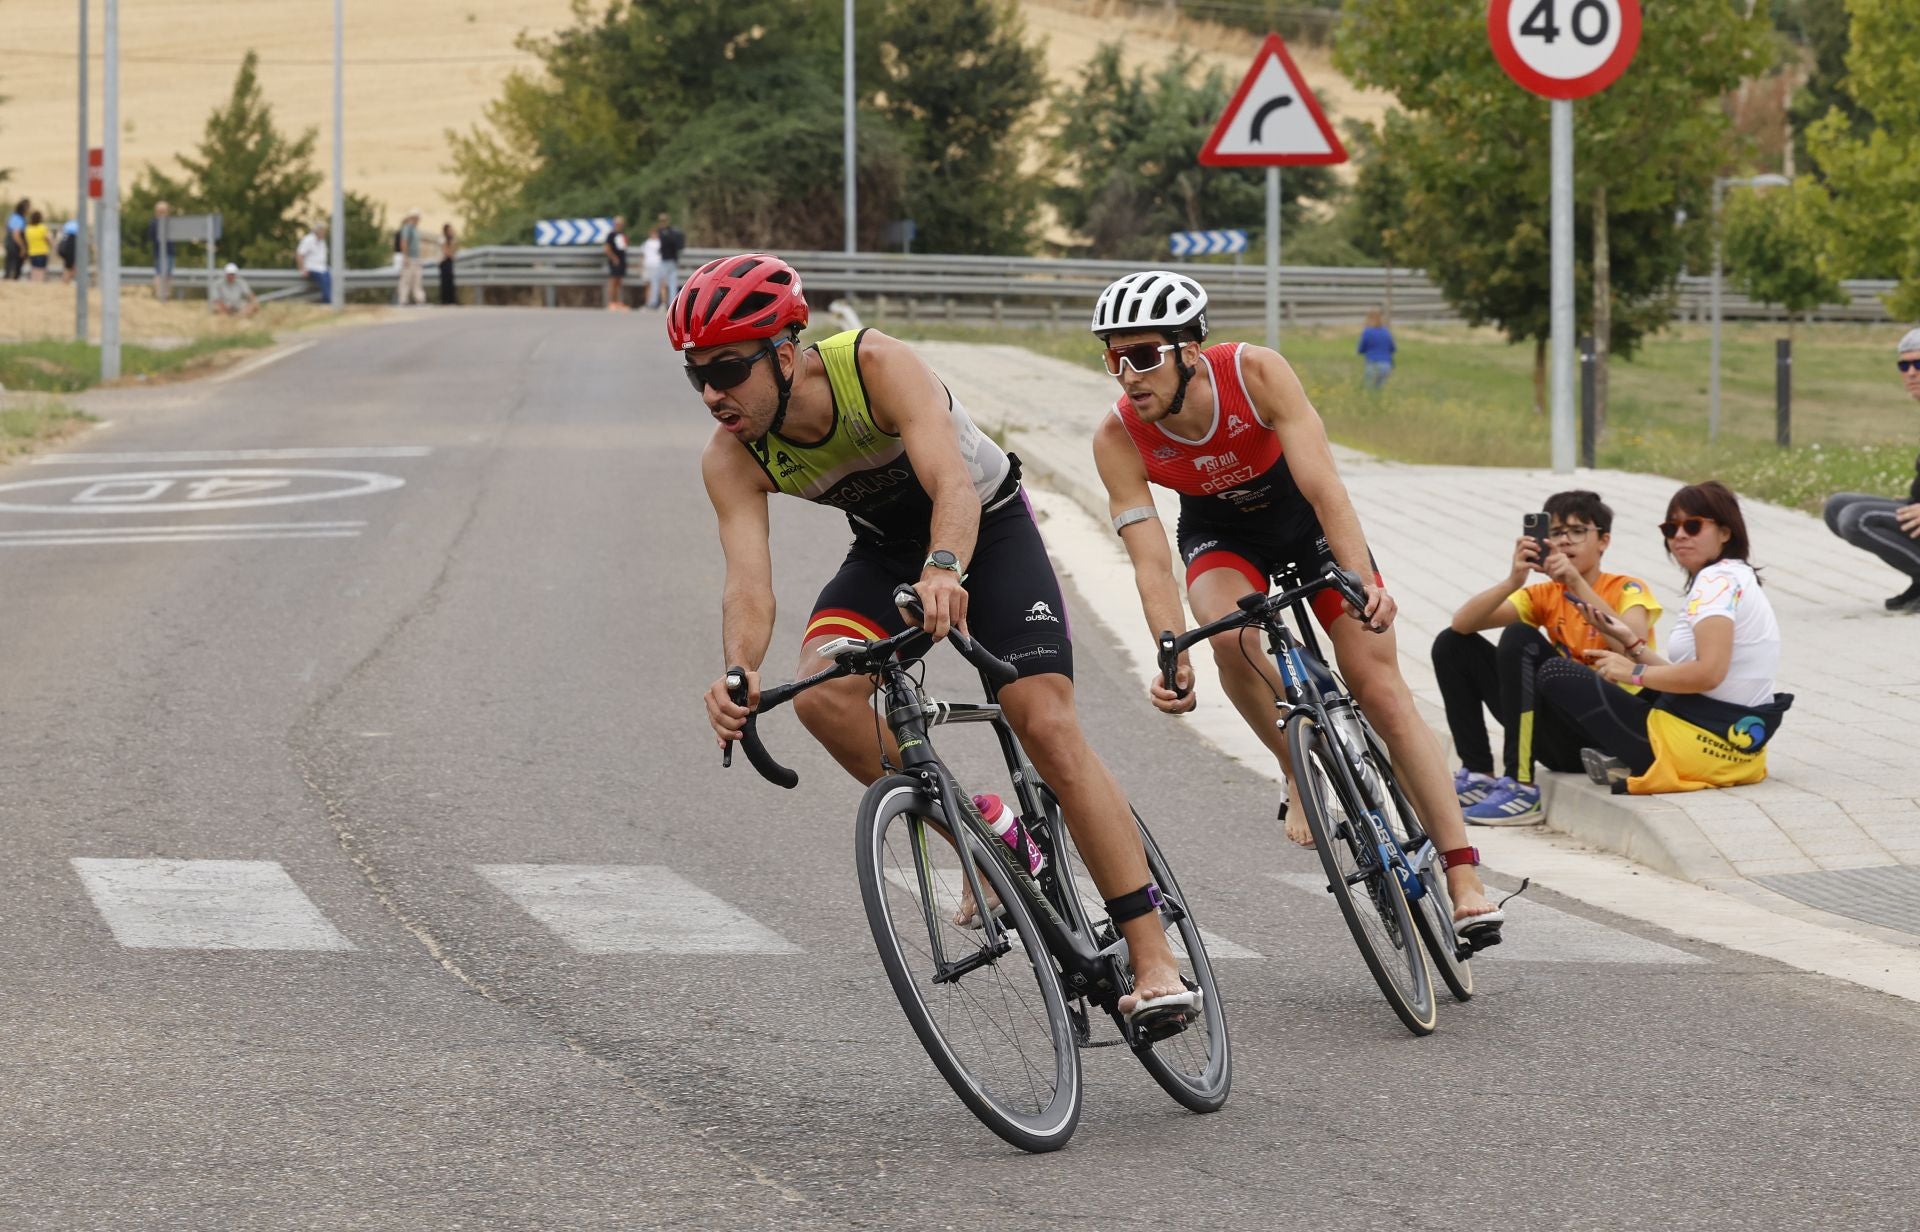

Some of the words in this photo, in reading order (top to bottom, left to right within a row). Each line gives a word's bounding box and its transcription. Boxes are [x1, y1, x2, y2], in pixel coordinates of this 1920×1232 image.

[1520, 0, 1609, 46] 40
[69, 477, 292, 502] 40
[1200, 465, 1261, 494] PÉREZ
[1281, 640, 1303, 698] ORBEA
